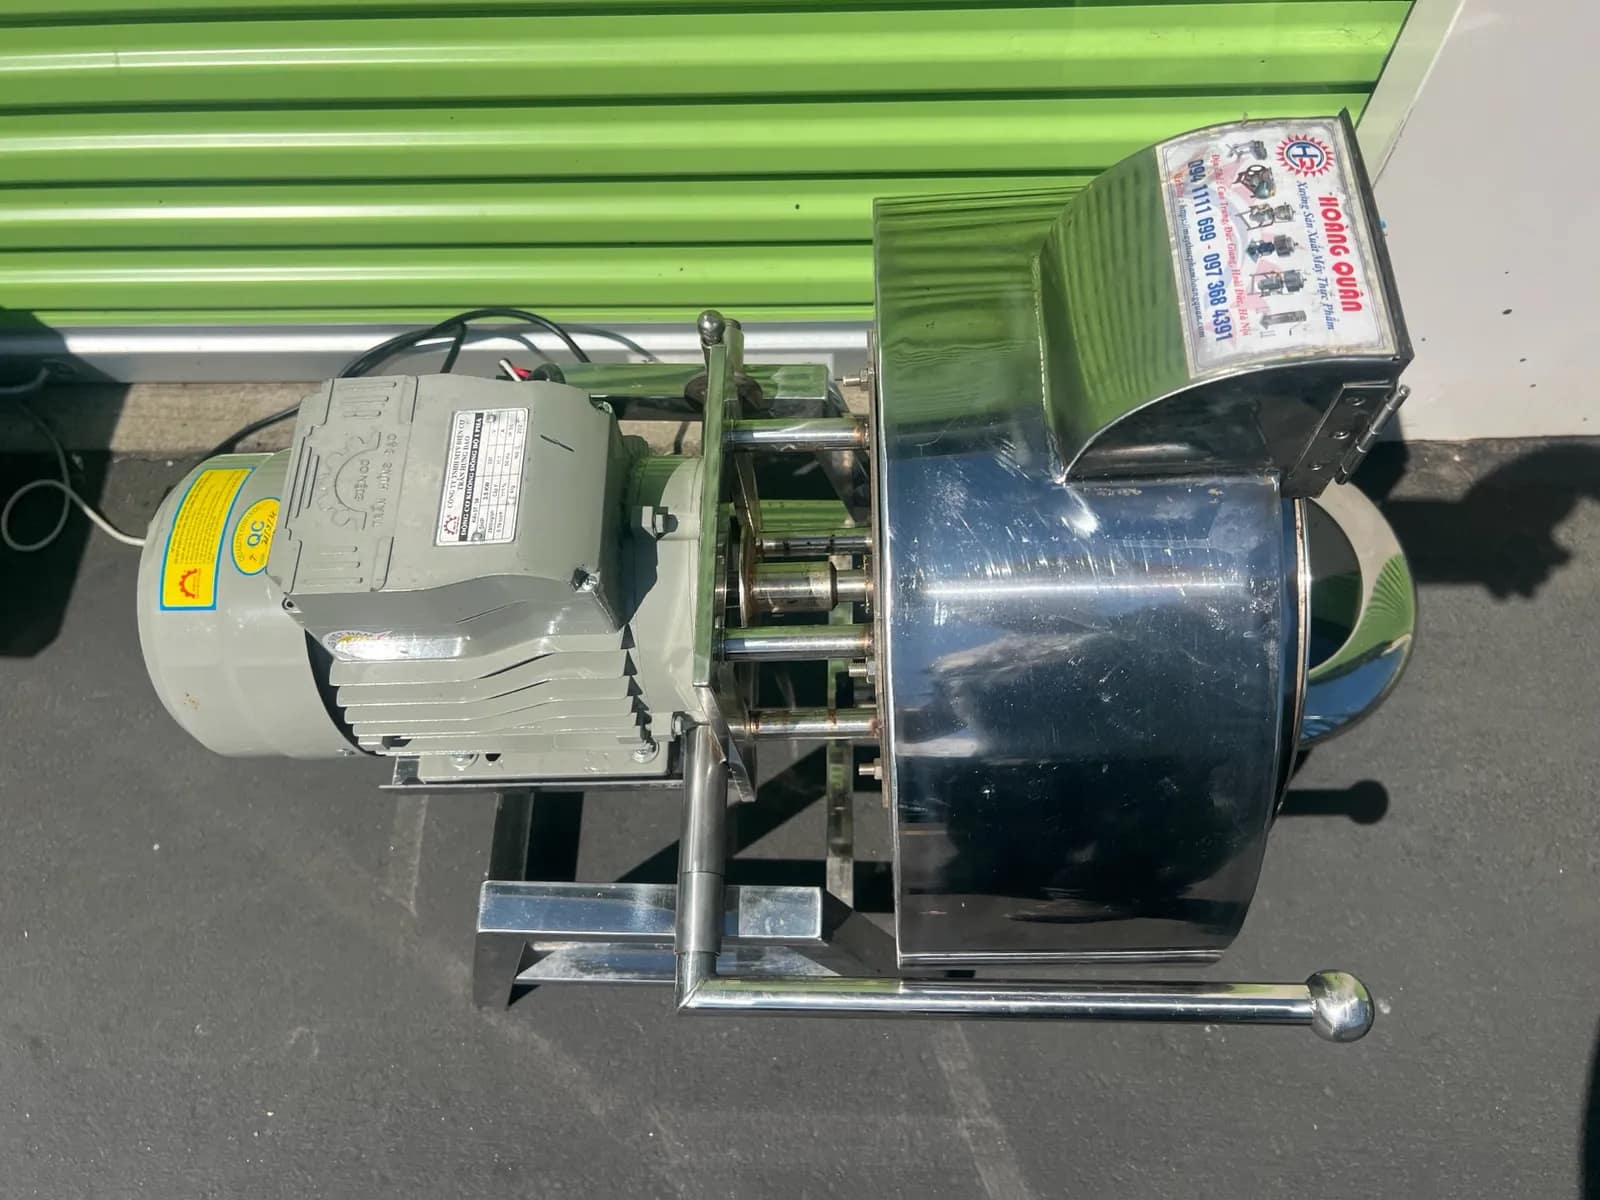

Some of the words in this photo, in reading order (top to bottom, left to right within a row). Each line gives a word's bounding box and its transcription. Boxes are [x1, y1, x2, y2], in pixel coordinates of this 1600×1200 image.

[1188, 160, 1206, 183] 094
[1192, 184, 1212, 214] 1111
[1197, 217, 1217, 242] 699
[1303, 211, 1316, 229] Sản
[1318, 196, 1350, 257] HOÀNG
[1308, 231, 1324, 252] Xuất
[1203, 253, 1223, 276] 097
[1312, 254, 1325, 274] Máy
[1208, 280, 1227, 306] 368
[1316, 277, 1331, 300] Thực
[1332, 262, 1364, 312] QUÂN
[1212, 309, 1233, 342] 4391
[1320, 303, 1339, 330] Phẩm
[474, 418, 482, 433] PHA
[471, 438, 479, 449] BỘ
[464, 473, 475, 499] KHÔNG
[447, 490, 458, 509] CÔNG
[246, 520, 264, 547] QC
[460, 513, 470, 536] ĐỘNG
